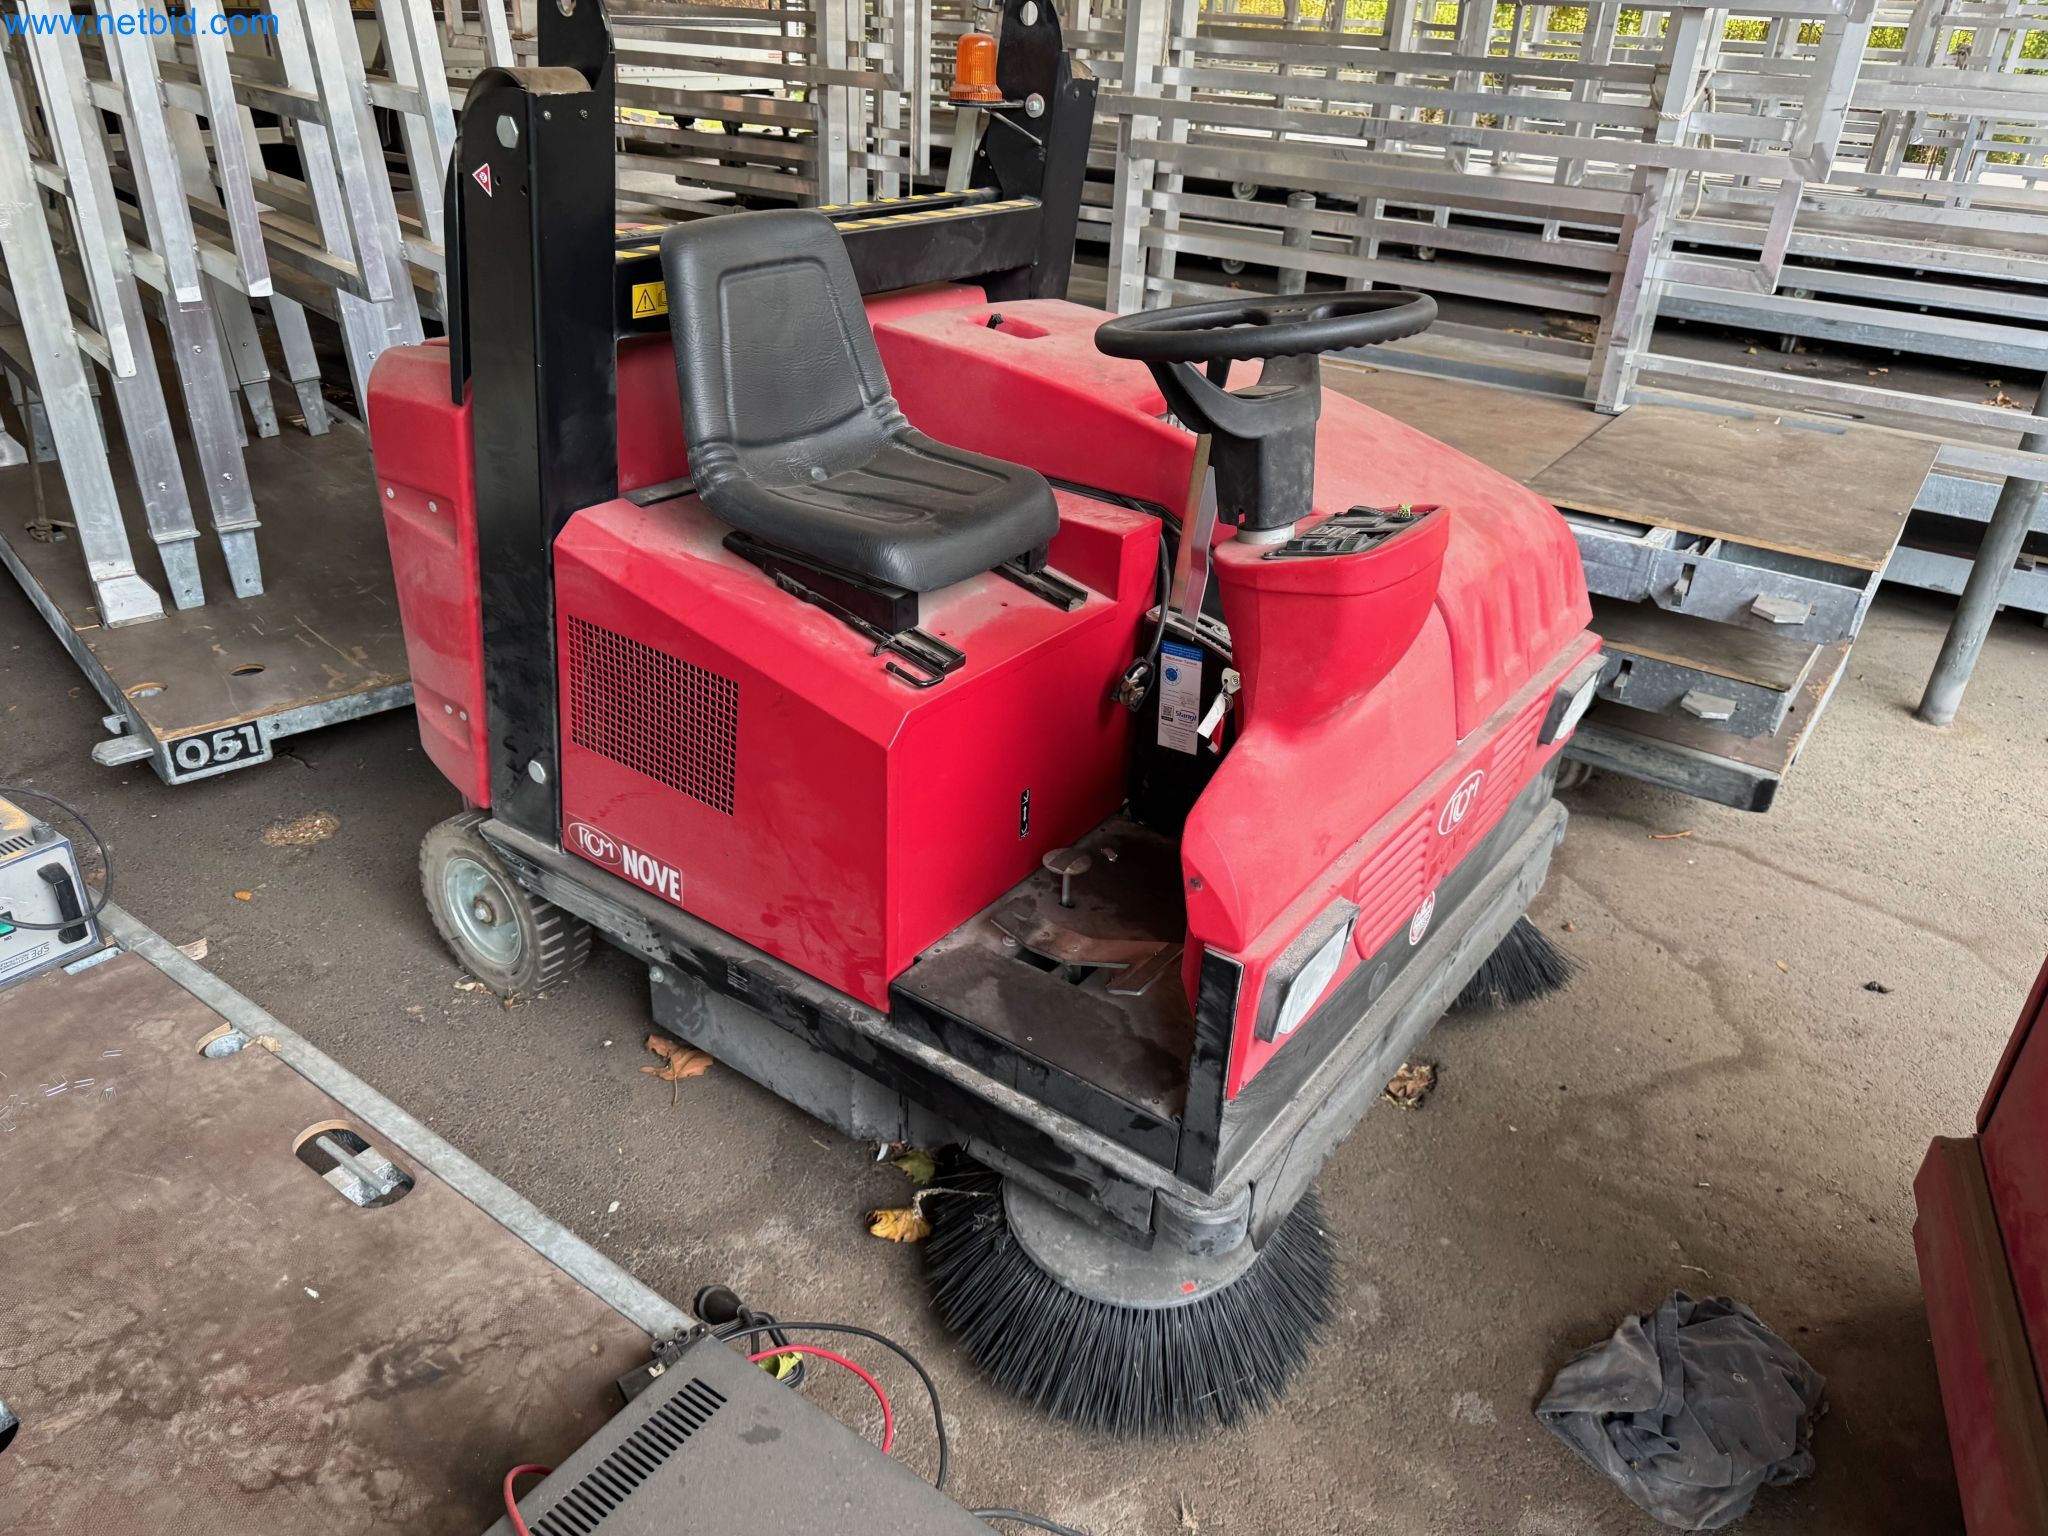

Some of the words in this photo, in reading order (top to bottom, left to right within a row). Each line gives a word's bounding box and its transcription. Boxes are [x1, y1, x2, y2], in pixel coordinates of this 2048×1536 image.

[176, 725, 259, 769] 051
[622, 844, 681, 902] NOVE
[31, 943, 50, 959] SPE
